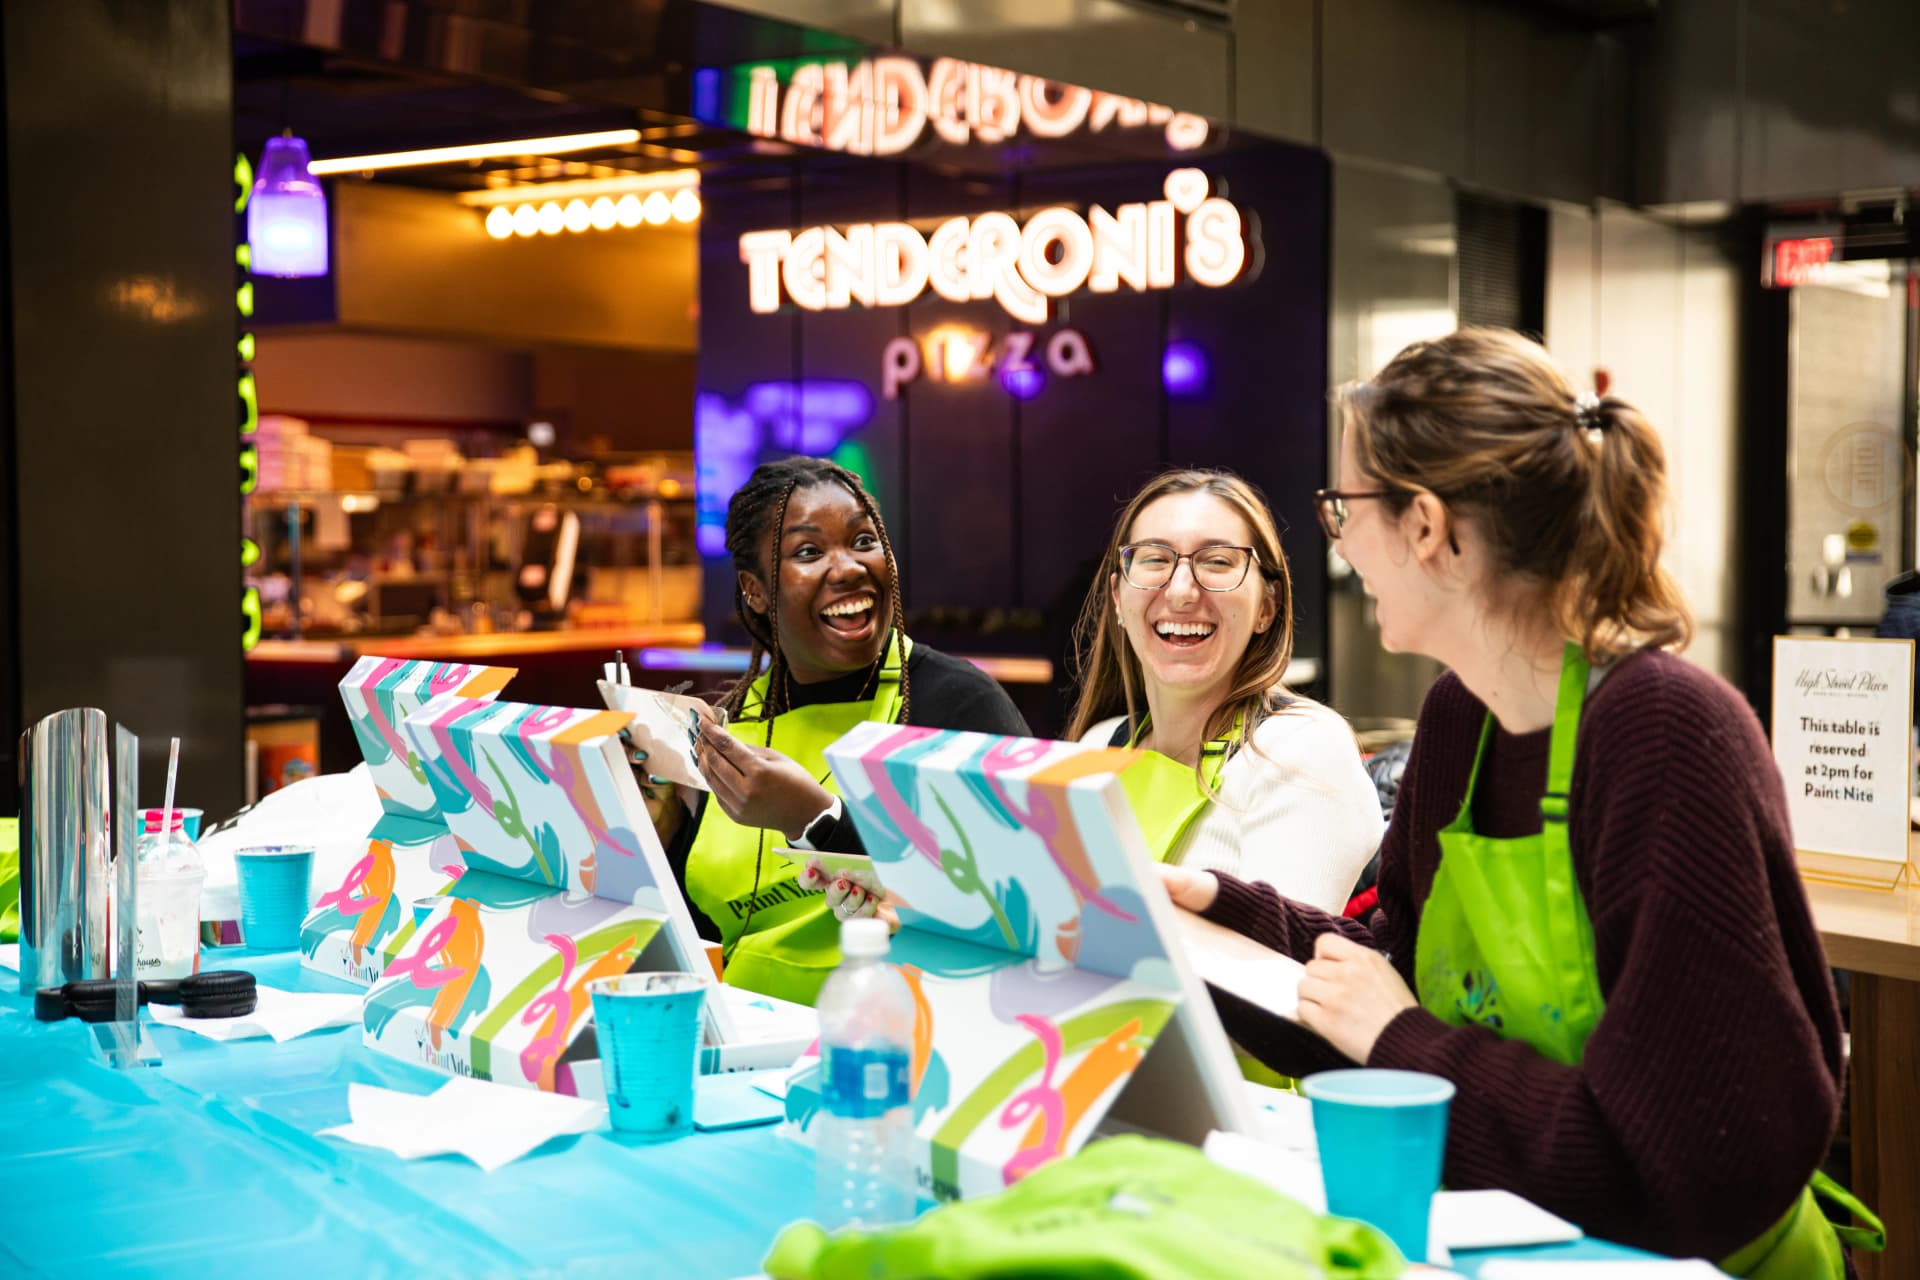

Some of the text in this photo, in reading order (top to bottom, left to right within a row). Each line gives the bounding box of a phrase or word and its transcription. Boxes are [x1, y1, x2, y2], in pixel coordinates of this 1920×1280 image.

[882, 326, 1094, 398] pizza
[1800, 716, 1880, 736] This table is
[1809, 742, 1866, 757] reserved
[1805, 763, 1873, 780] at 2pm for
[1805, 782, 1873, 802] Paint Nite
